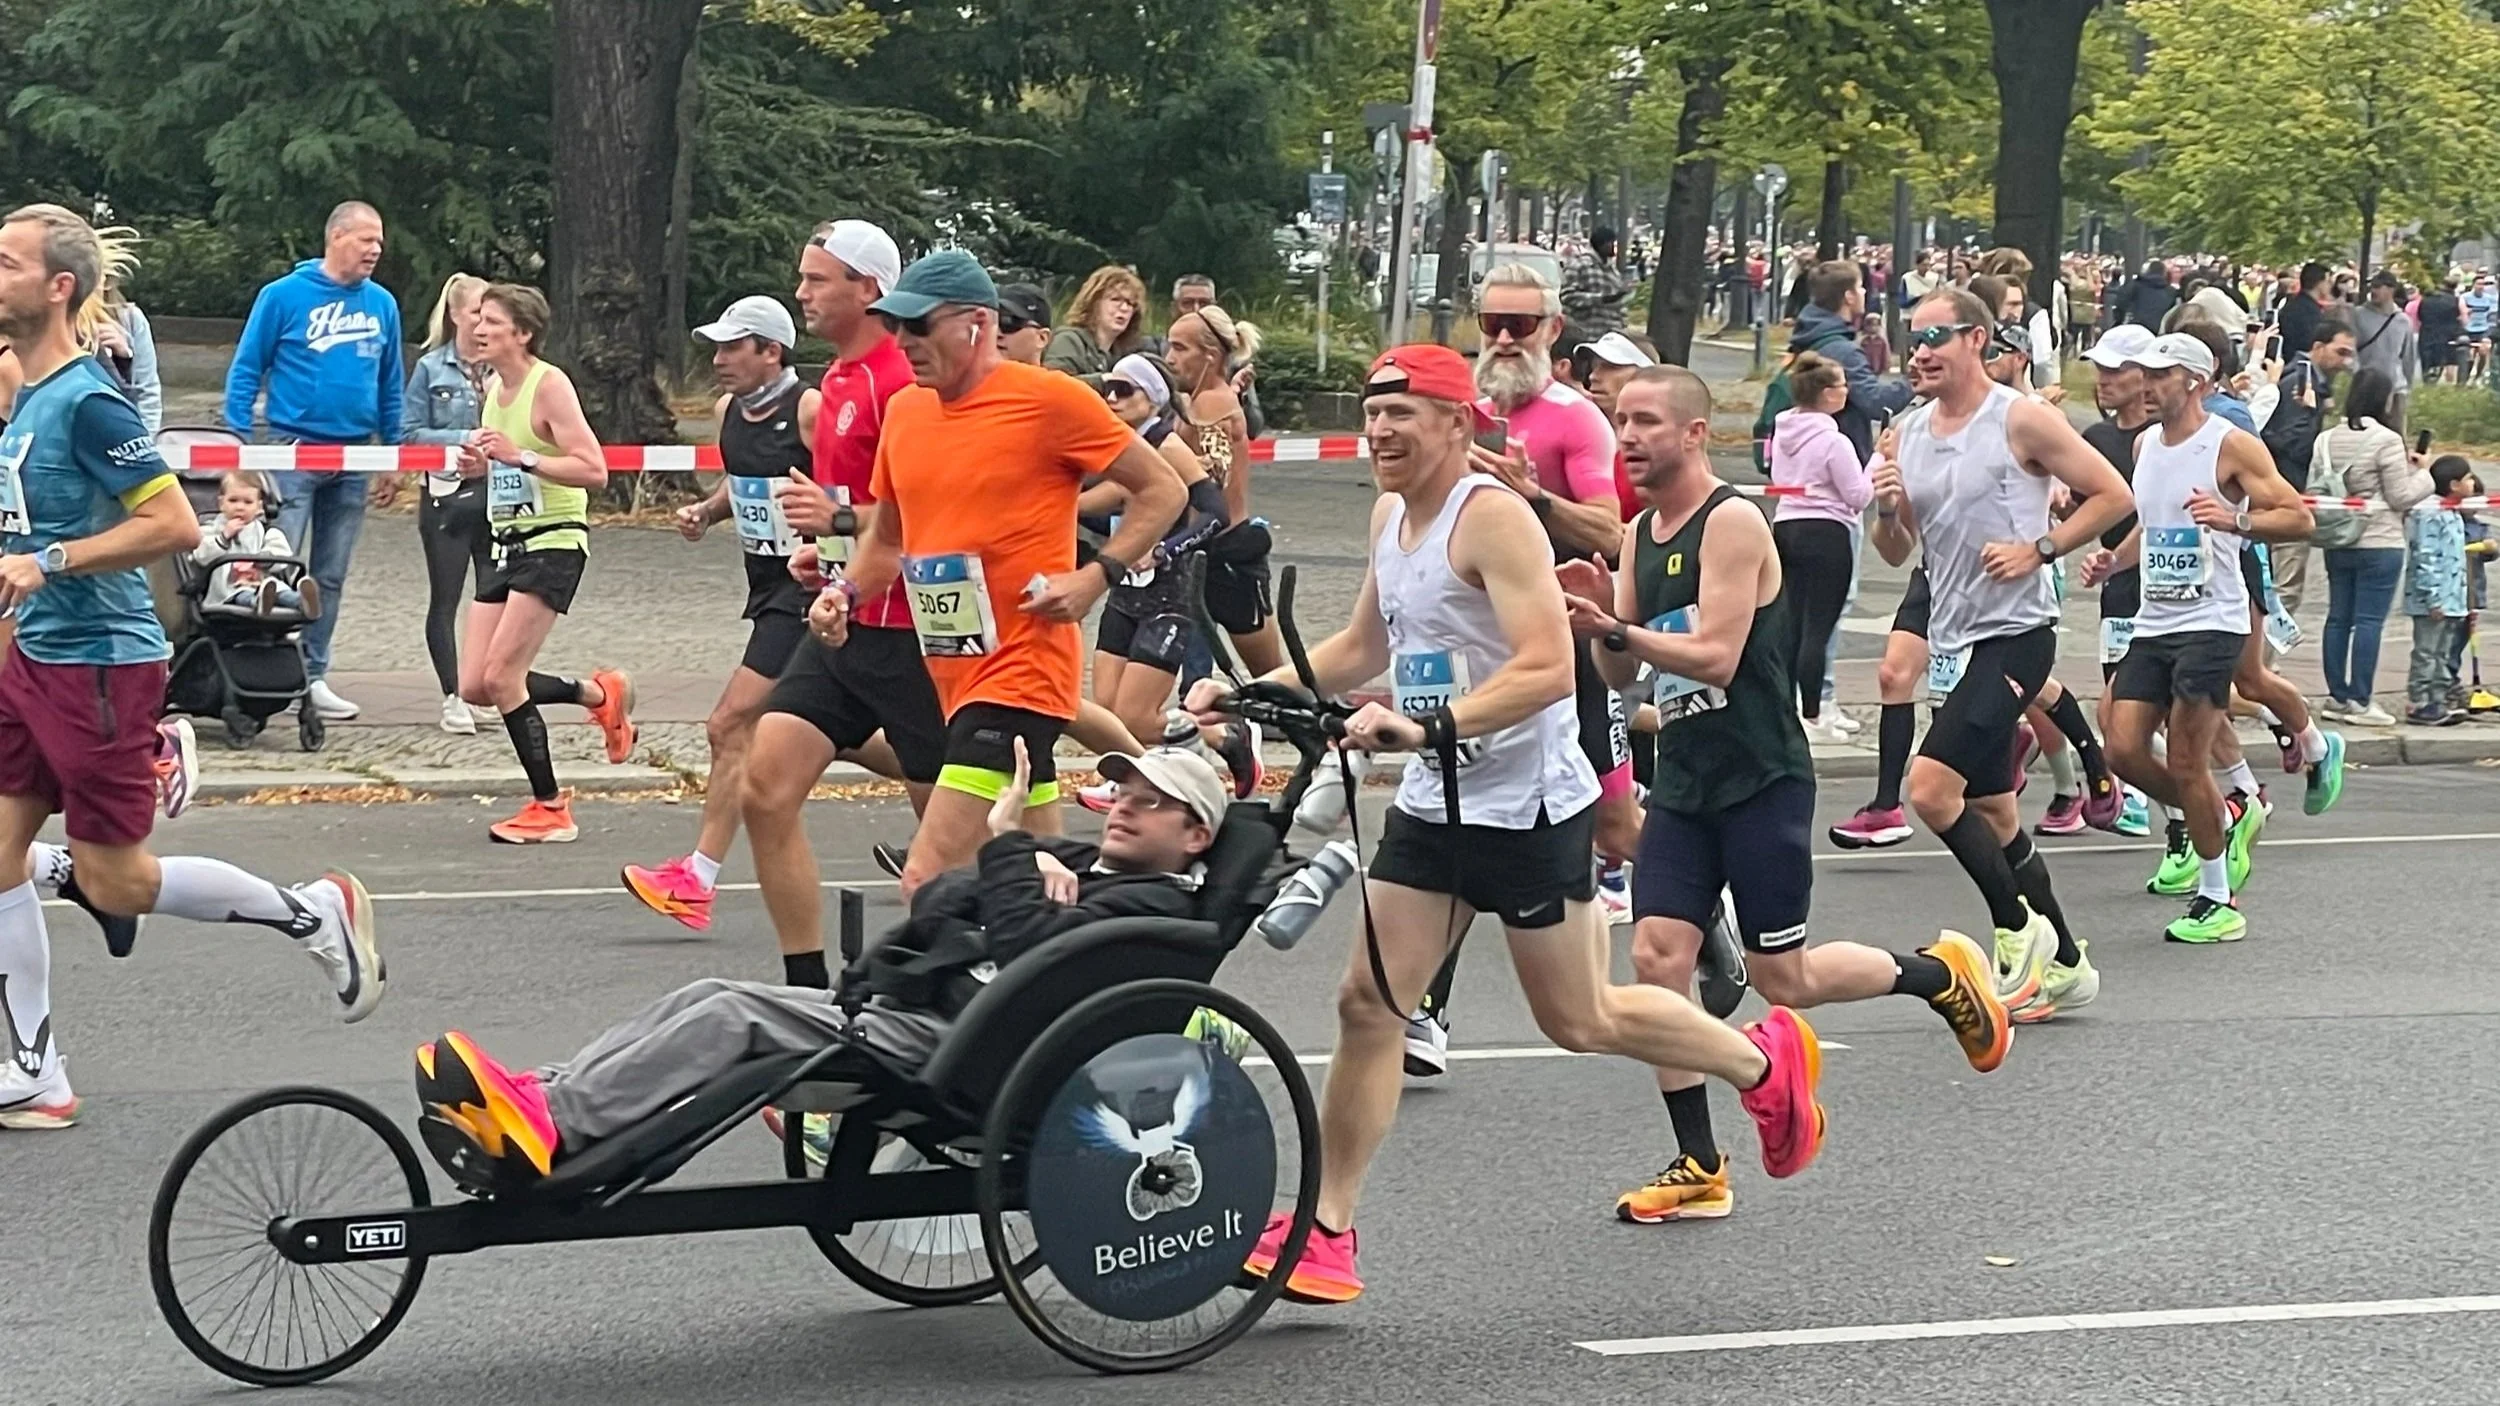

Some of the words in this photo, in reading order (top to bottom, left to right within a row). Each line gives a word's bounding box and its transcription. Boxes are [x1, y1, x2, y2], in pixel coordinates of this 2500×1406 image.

[492, 474, 522, 490] 31523
[2148, 553, 2198, 569] 30462
[917, 591, 960, 614] 5067
[351, 1227, 400, 1246] YETI
[1095, 1224, 1214, 1276] Believe
[1224, 1209, 1243, 1239] It
